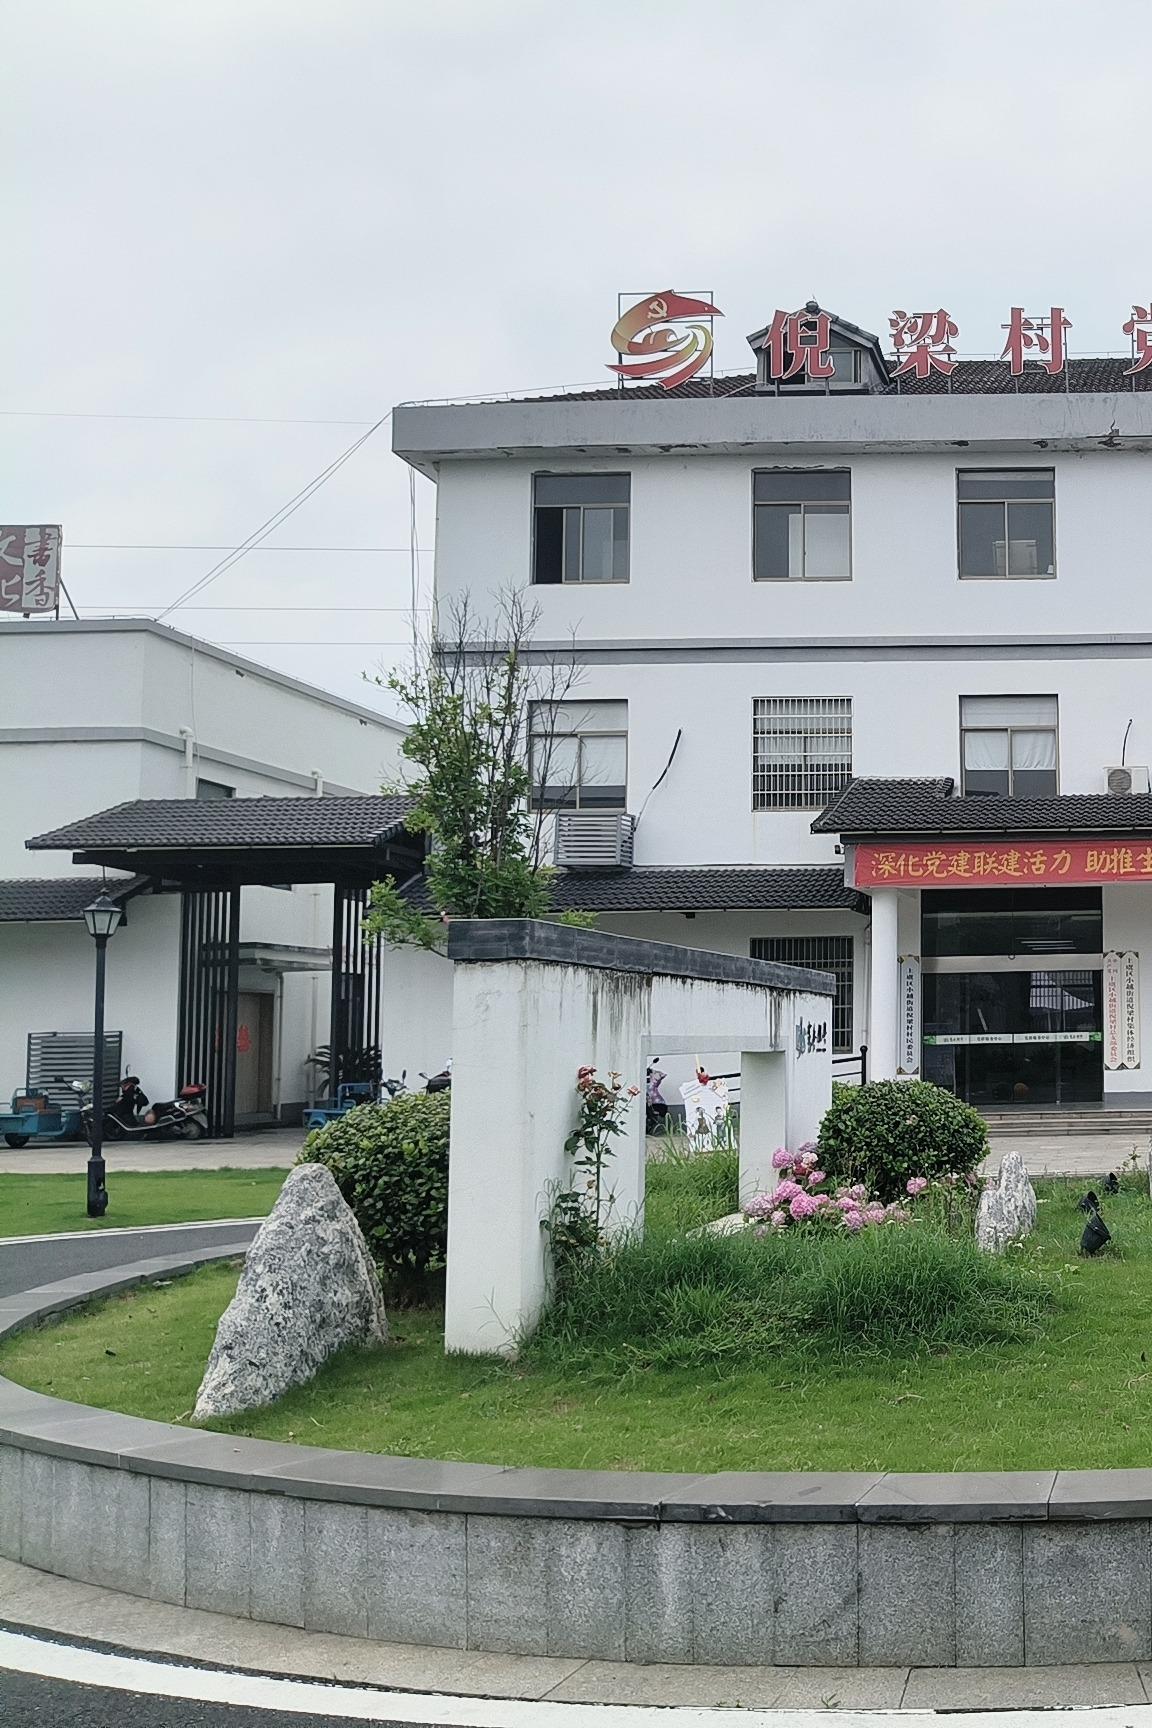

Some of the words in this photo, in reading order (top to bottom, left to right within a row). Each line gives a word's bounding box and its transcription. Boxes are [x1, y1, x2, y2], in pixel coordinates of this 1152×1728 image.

[870, 850, 1072, 879] 深化党建联建活力
